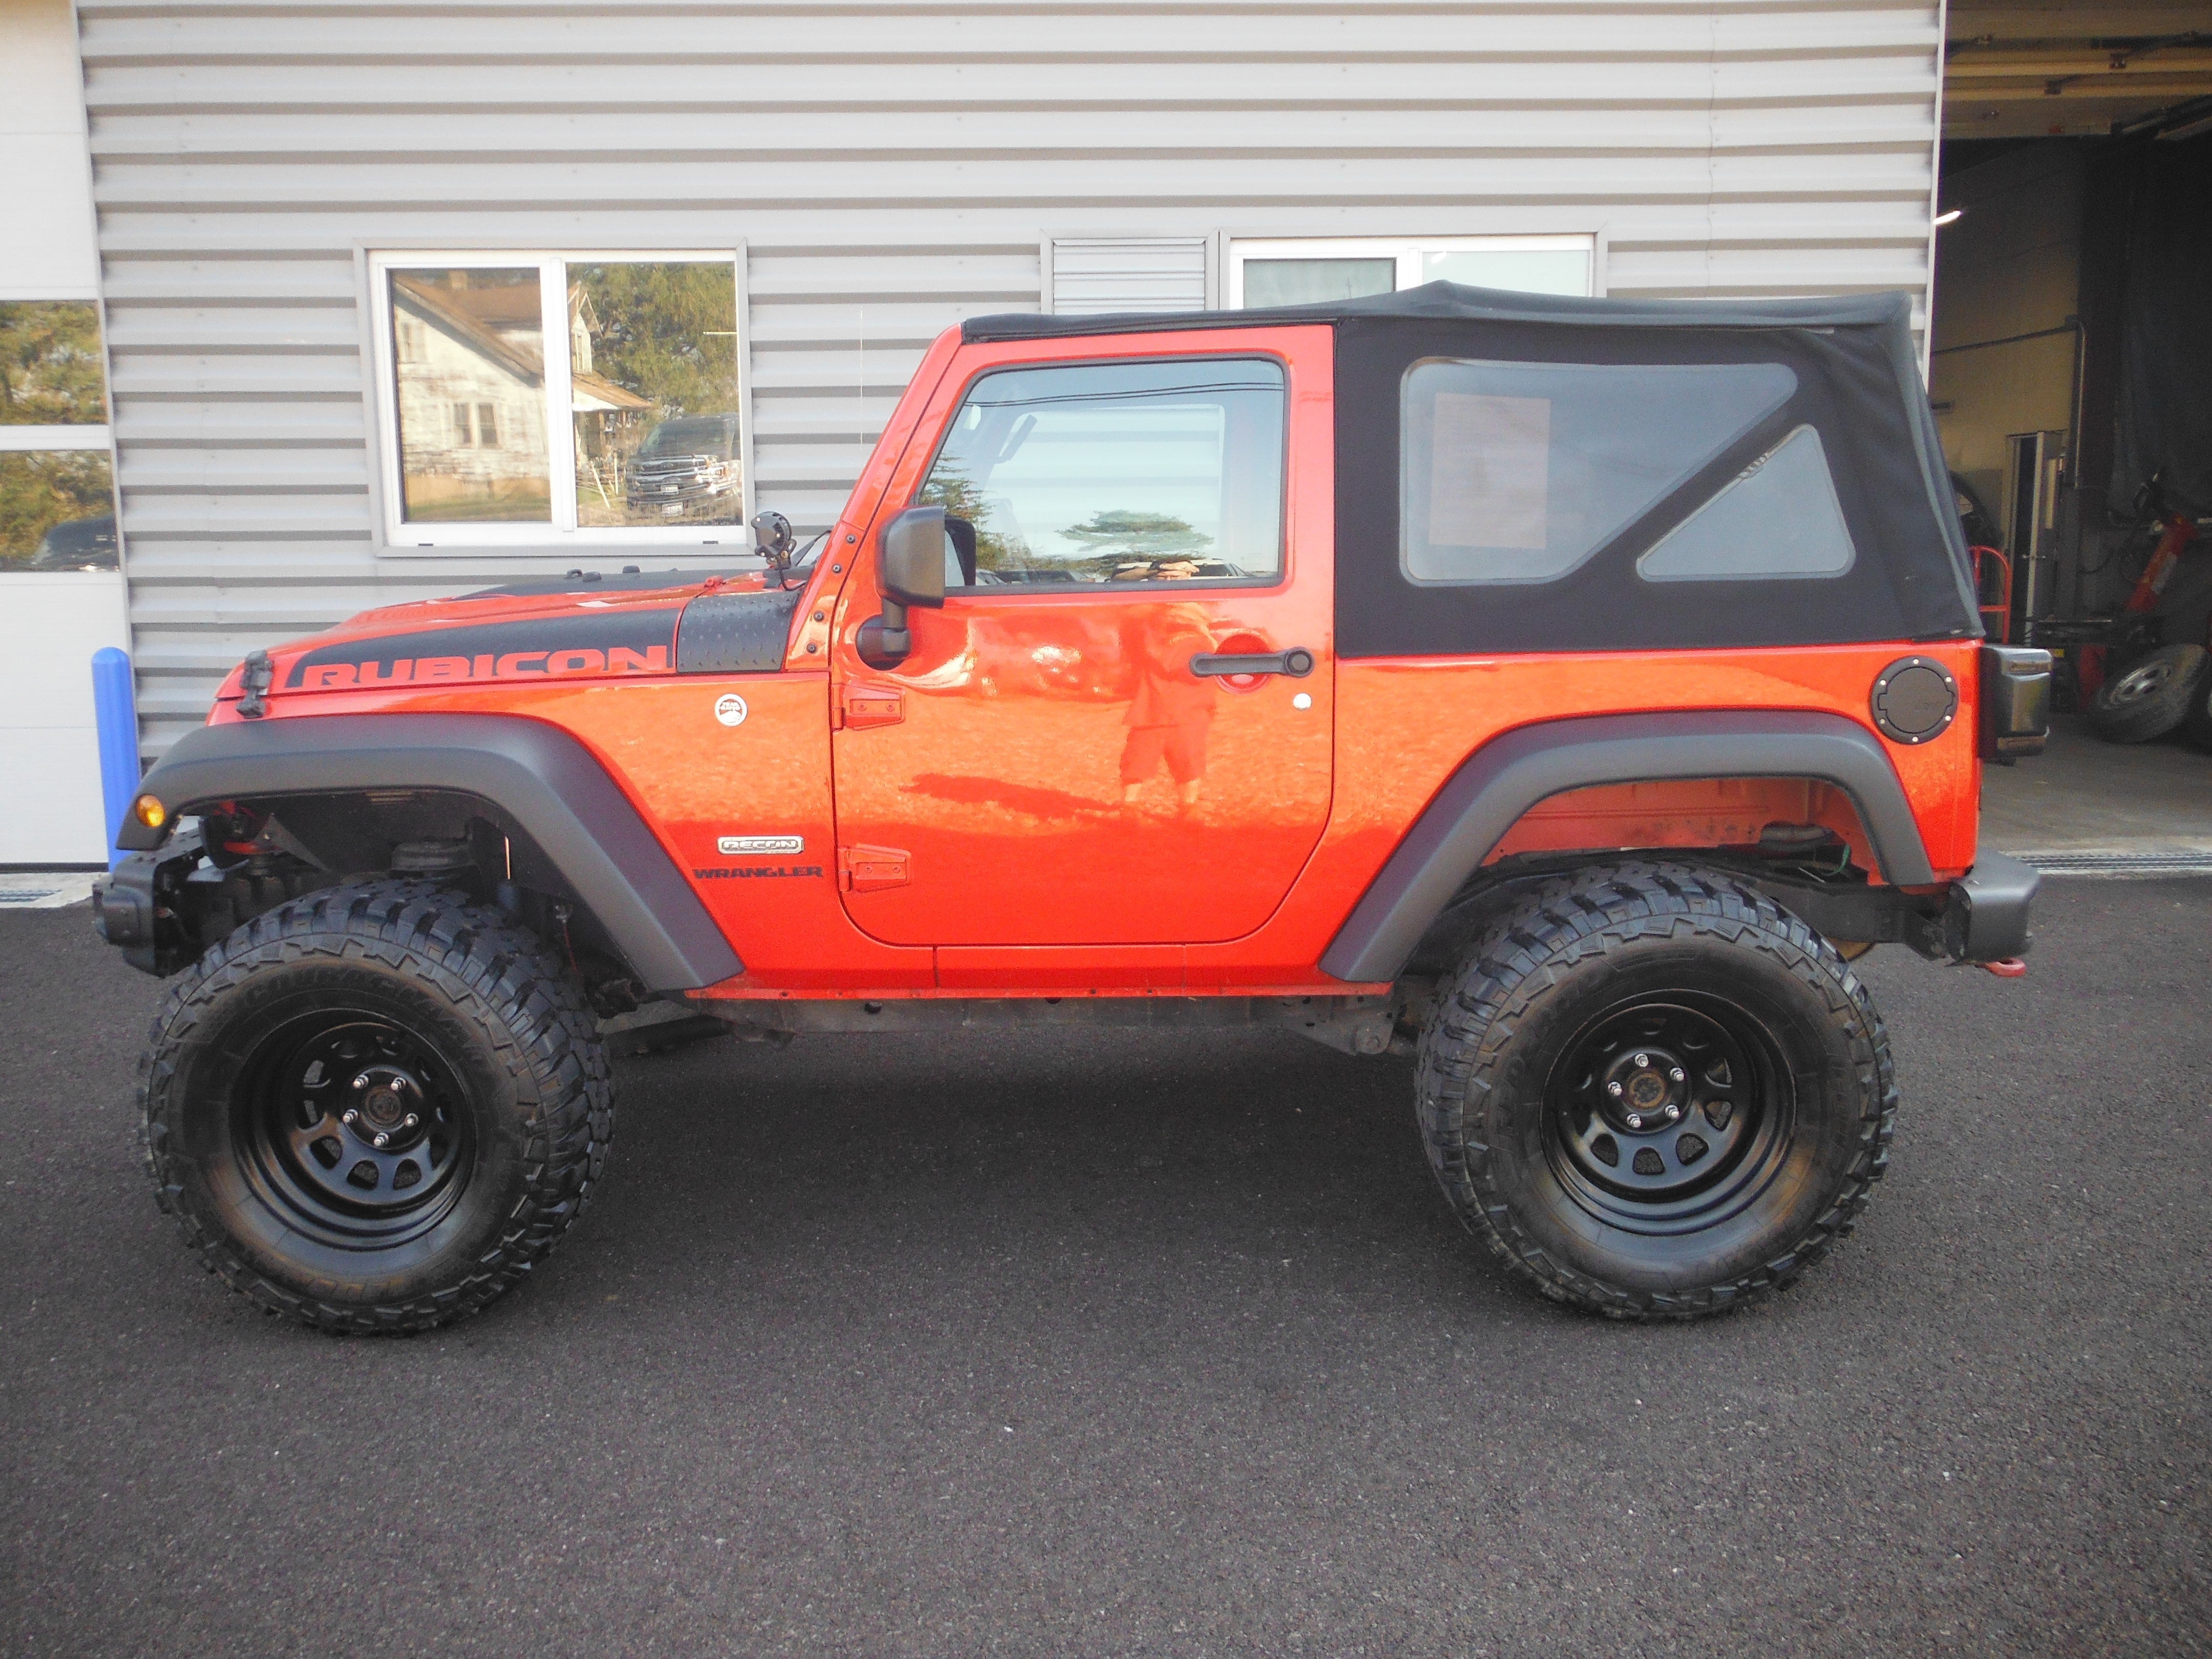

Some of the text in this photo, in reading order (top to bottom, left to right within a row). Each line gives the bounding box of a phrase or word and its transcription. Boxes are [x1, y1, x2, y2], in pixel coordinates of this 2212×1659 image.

[302, 646, 668, 687] RUBICON
[722, 840, 796, 849] RECON
[692, 866, 823, 879] WRANGLER
